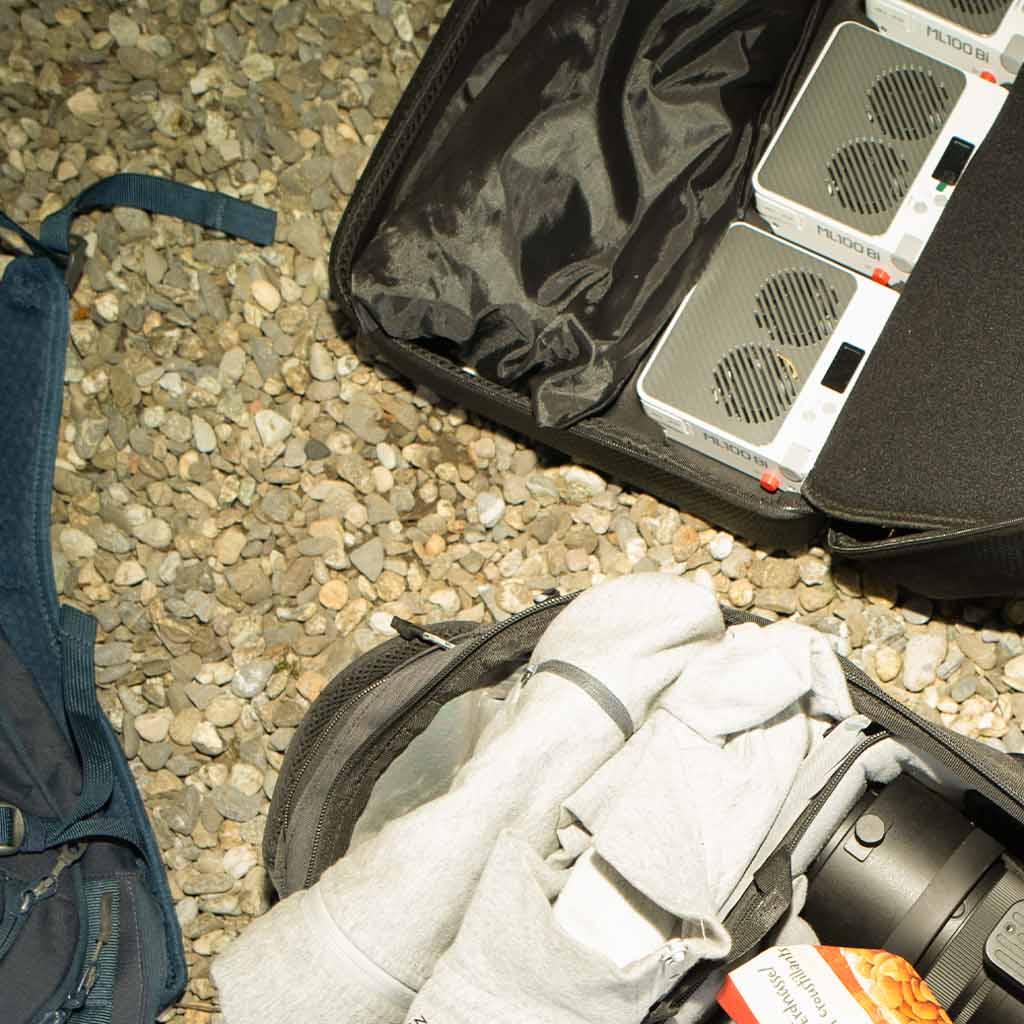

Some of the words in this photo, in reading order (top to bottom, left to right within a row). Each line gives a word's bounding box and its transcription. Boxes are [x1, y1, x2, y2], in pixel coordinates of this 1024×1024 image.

[926, 25, 973, 56] ML100
[975, 47, 990, 63] Bi
[816, 224, 864, 254] ML100
[866, 247, 881, 261] Bi
